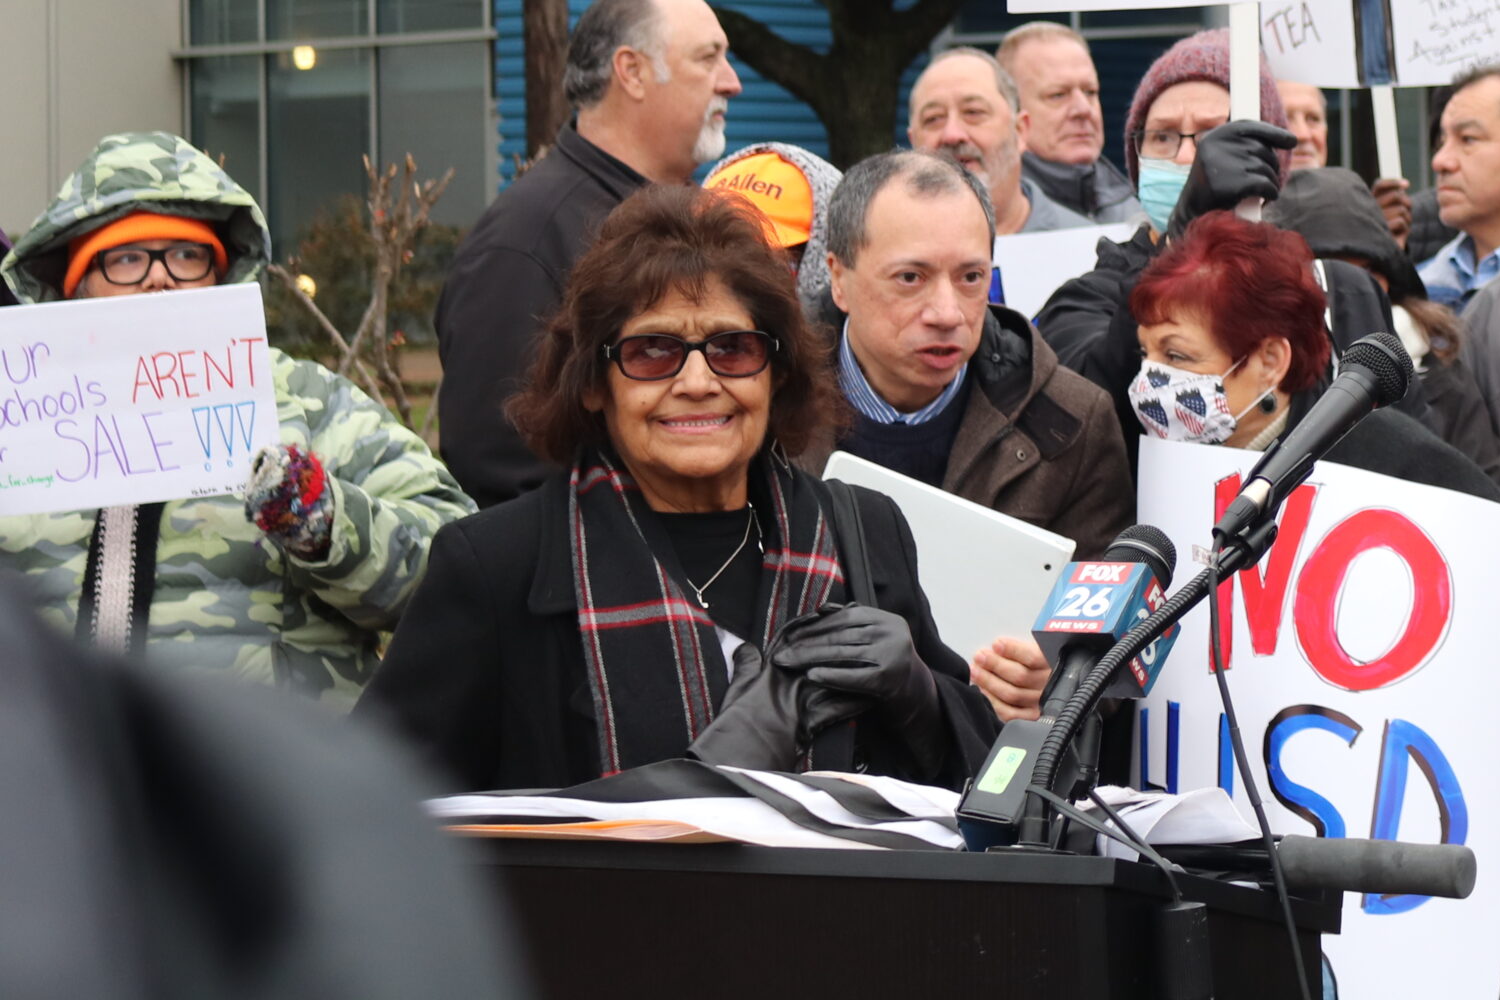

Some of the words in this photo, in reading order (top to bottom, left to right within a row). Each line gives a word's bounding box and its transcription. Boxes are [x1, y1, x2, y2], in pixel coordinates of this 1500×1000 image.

[1265, 0, 1322, 54] TEA
[132, 337, 263, 404] AREN'T
[54, 411, 181, 482] SALE
[1077, 564, 1127, 582] FOX
[1209, 471, 1454, 692] NO
[1049, 621, 1099, 631] NEWS
[1054, 586, 1114, 618] 26
